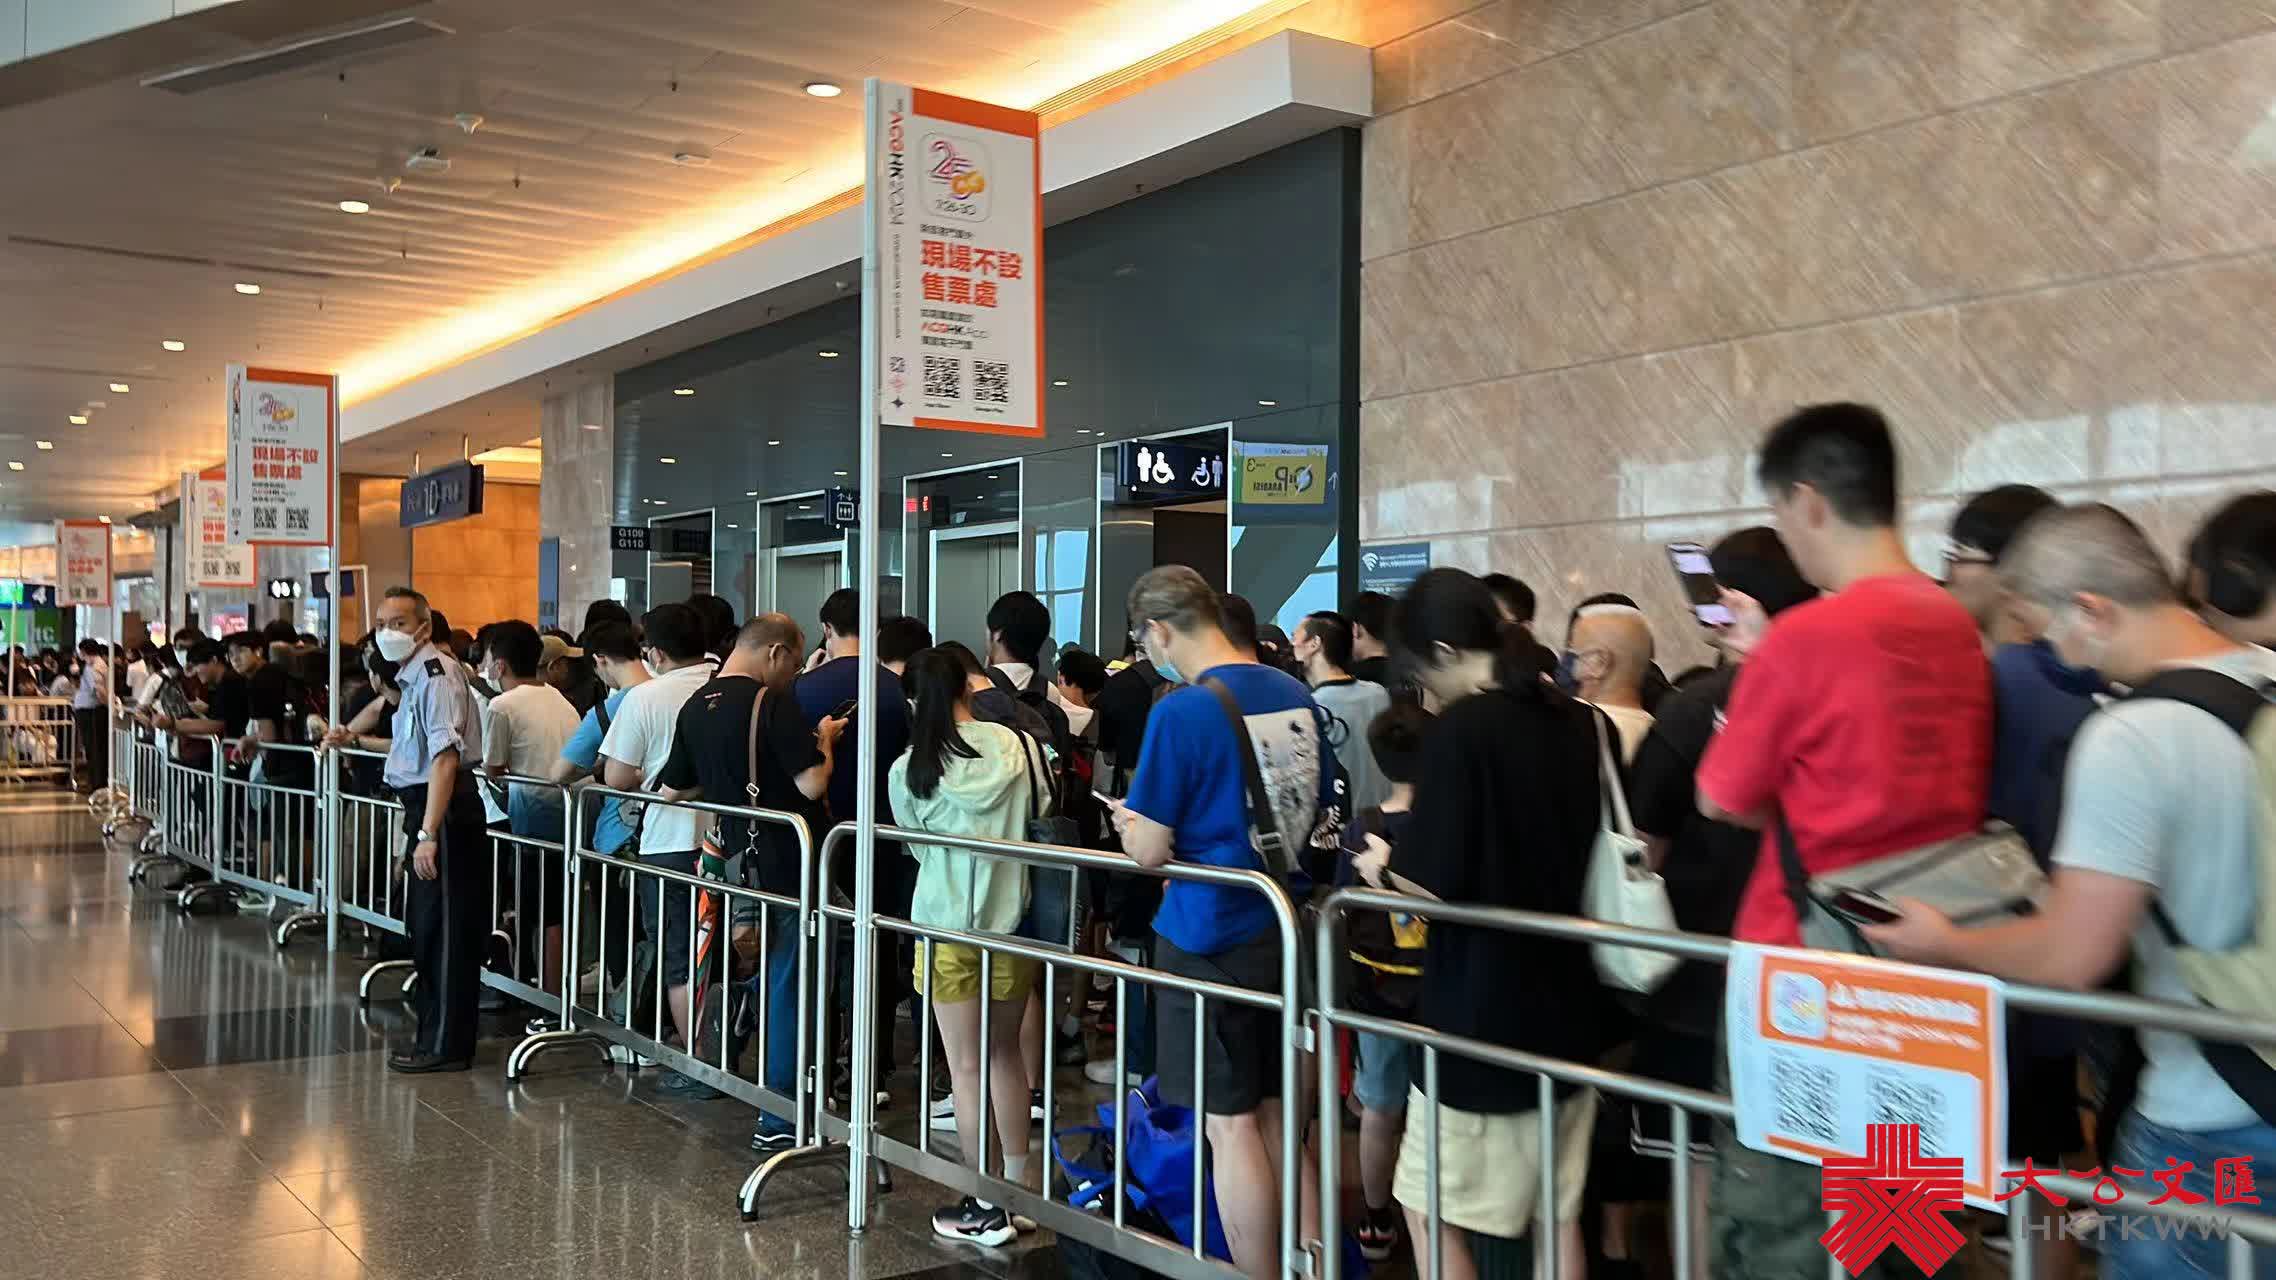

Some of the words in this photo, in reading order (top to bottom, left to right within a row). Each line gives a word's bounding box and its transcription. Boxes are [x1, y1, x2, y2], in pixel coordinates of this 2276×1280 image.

[921, 239, 1023, 280] 現場不設
[921, 271, 999, 308] 售票處
[618, 539, 644, 548] G110
